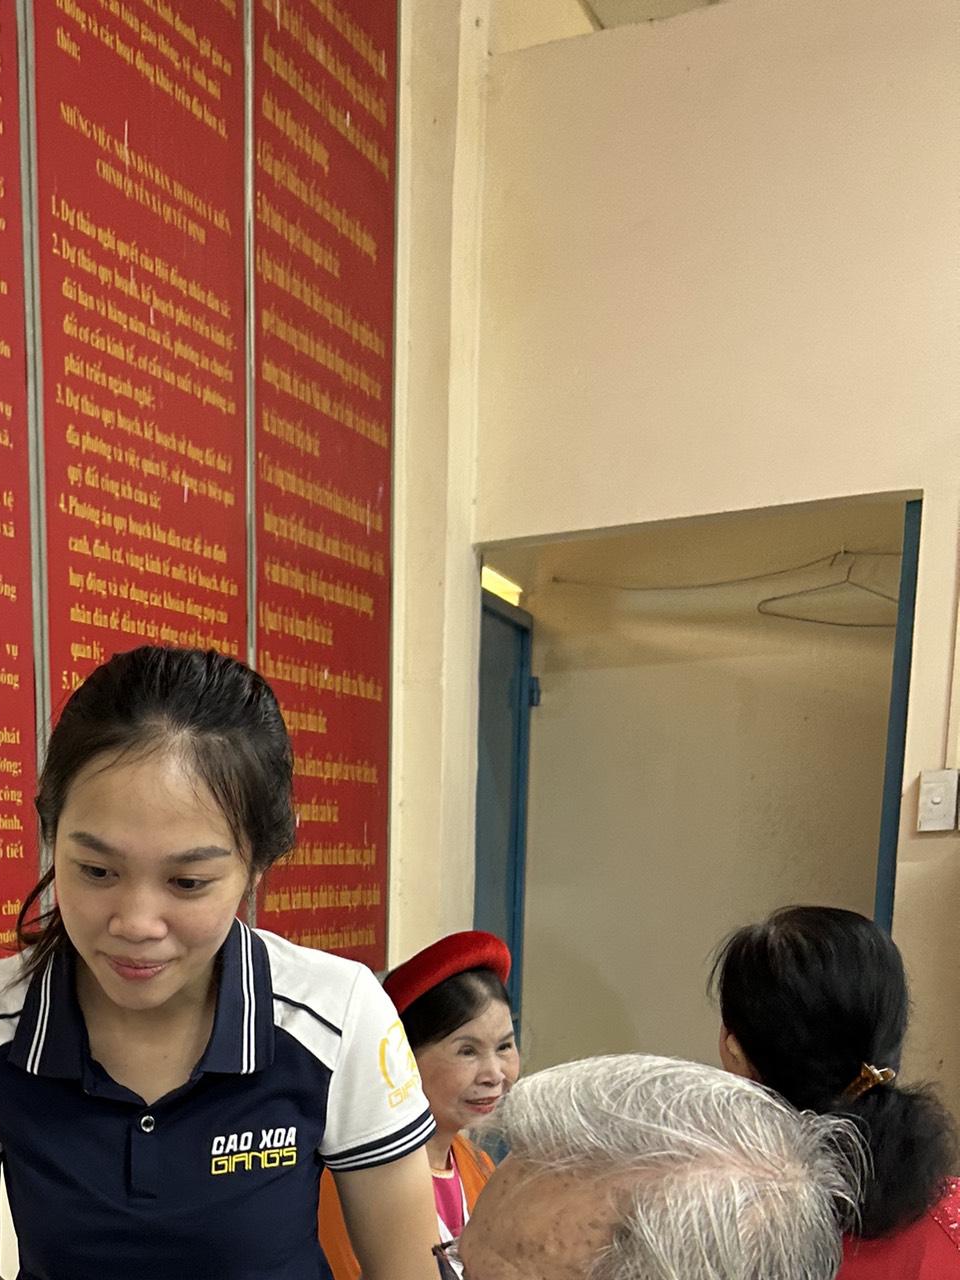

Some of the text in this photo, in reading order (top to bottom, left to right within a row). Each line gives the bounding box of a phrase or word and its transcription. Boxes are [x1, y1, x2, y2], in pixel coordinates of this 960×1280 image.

[0, 896, 22, 917] chứ
[212, 1126, 297, 1156] CAO XOA
[211, 1146, 297, 1175] GIANG'S
